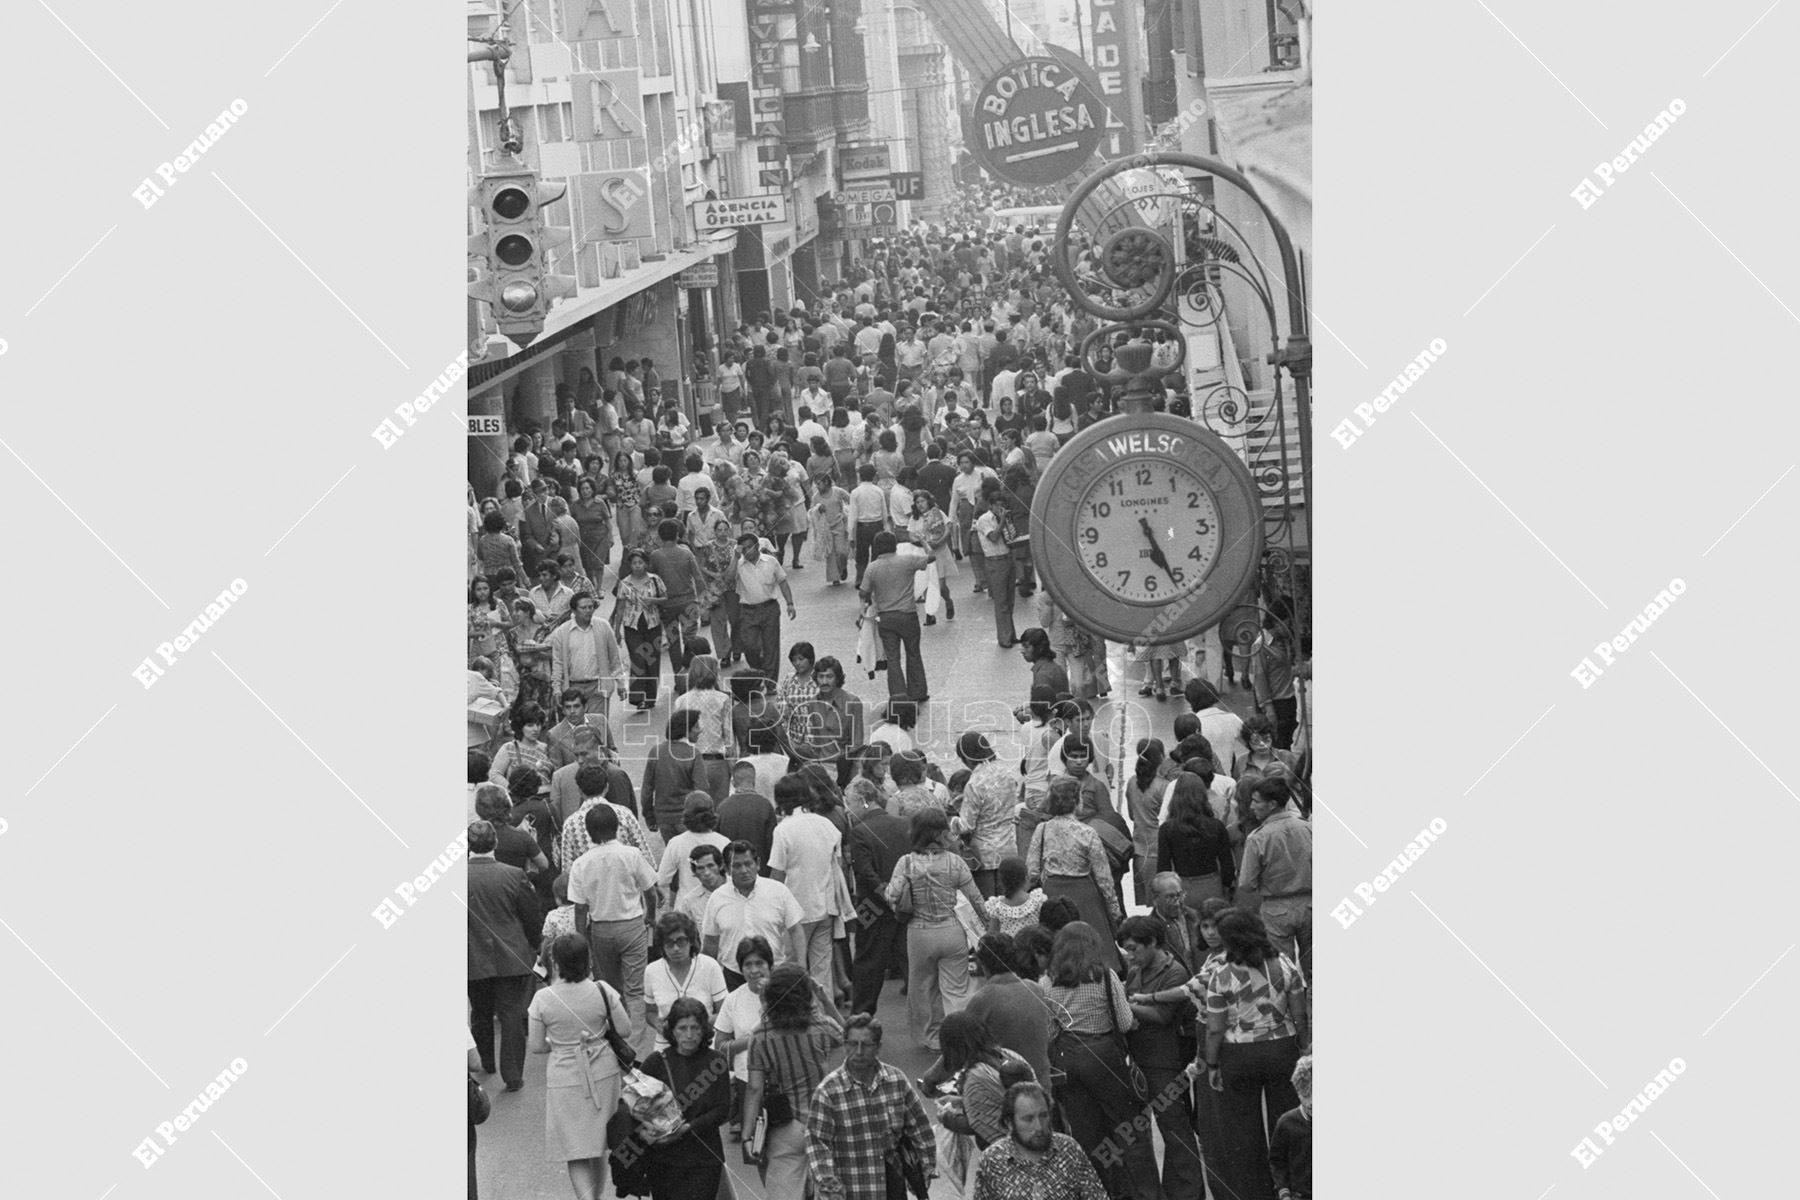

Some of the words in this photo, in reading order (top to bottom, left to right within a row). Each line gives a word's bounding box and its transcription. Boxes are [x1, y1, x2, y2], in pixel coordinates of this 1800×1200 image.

[1094, 0, 1124, 155] ADELI
[983, 63, 1080, 117] BOTICA
[984, 103, 1096, 150] INGLESA
[845, 155, 884, 171] Kodak
[836, 190, 895, 205] OMEGA
[706, 201, 778, 215] AGENCIA
[467, 418, 500, 434] BLES
[1135, 469, 1153, 486] 12
[1169, 476, 1177, 493] 1
[1109, 479, 1124, 496] 11
[1187, 492, 1200, 509] 2
[1091, 502, 1111, 518] 10
[1195, 518, 1210, 535] 3
[1084, 527, 1099, 545] 9
[1095, 552, 1108, 568] 8
[1187, 545, 1203, 562] 4
[1117, 570, 1131, 587] 7
[1144, 575, 1158, 592] 6
[1172, 567, 1185, 583] 5
